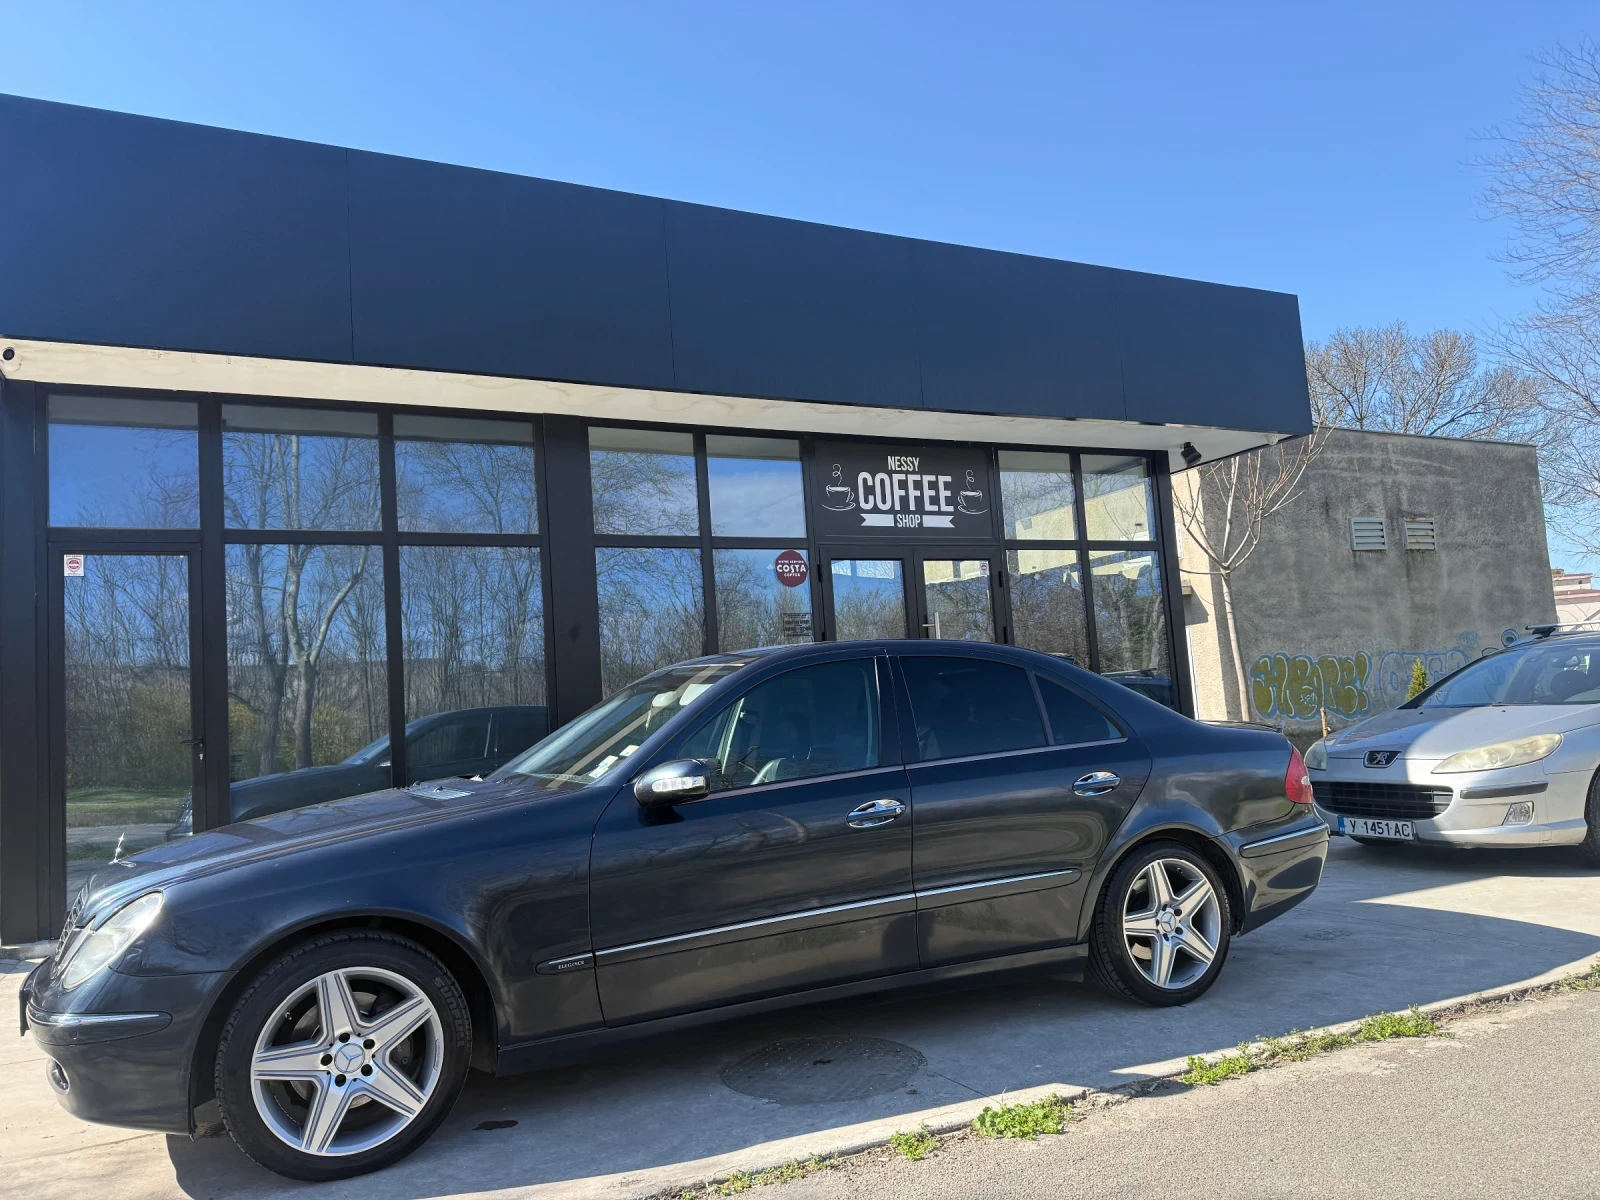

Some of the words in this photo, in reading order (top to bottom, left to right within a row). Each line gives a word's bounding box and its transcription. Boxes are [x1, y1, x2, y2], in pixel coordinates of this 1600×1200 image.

[887, 455, 919, 472] NESSY
[857, 471, 954, 512] COFFEE
[896, 514, 921, 528] SHOP
[776, 564, 806, 573] COSTA
[1363, 821, 1390, 836] 1451
[1394, 823, 1410, 837] AC
